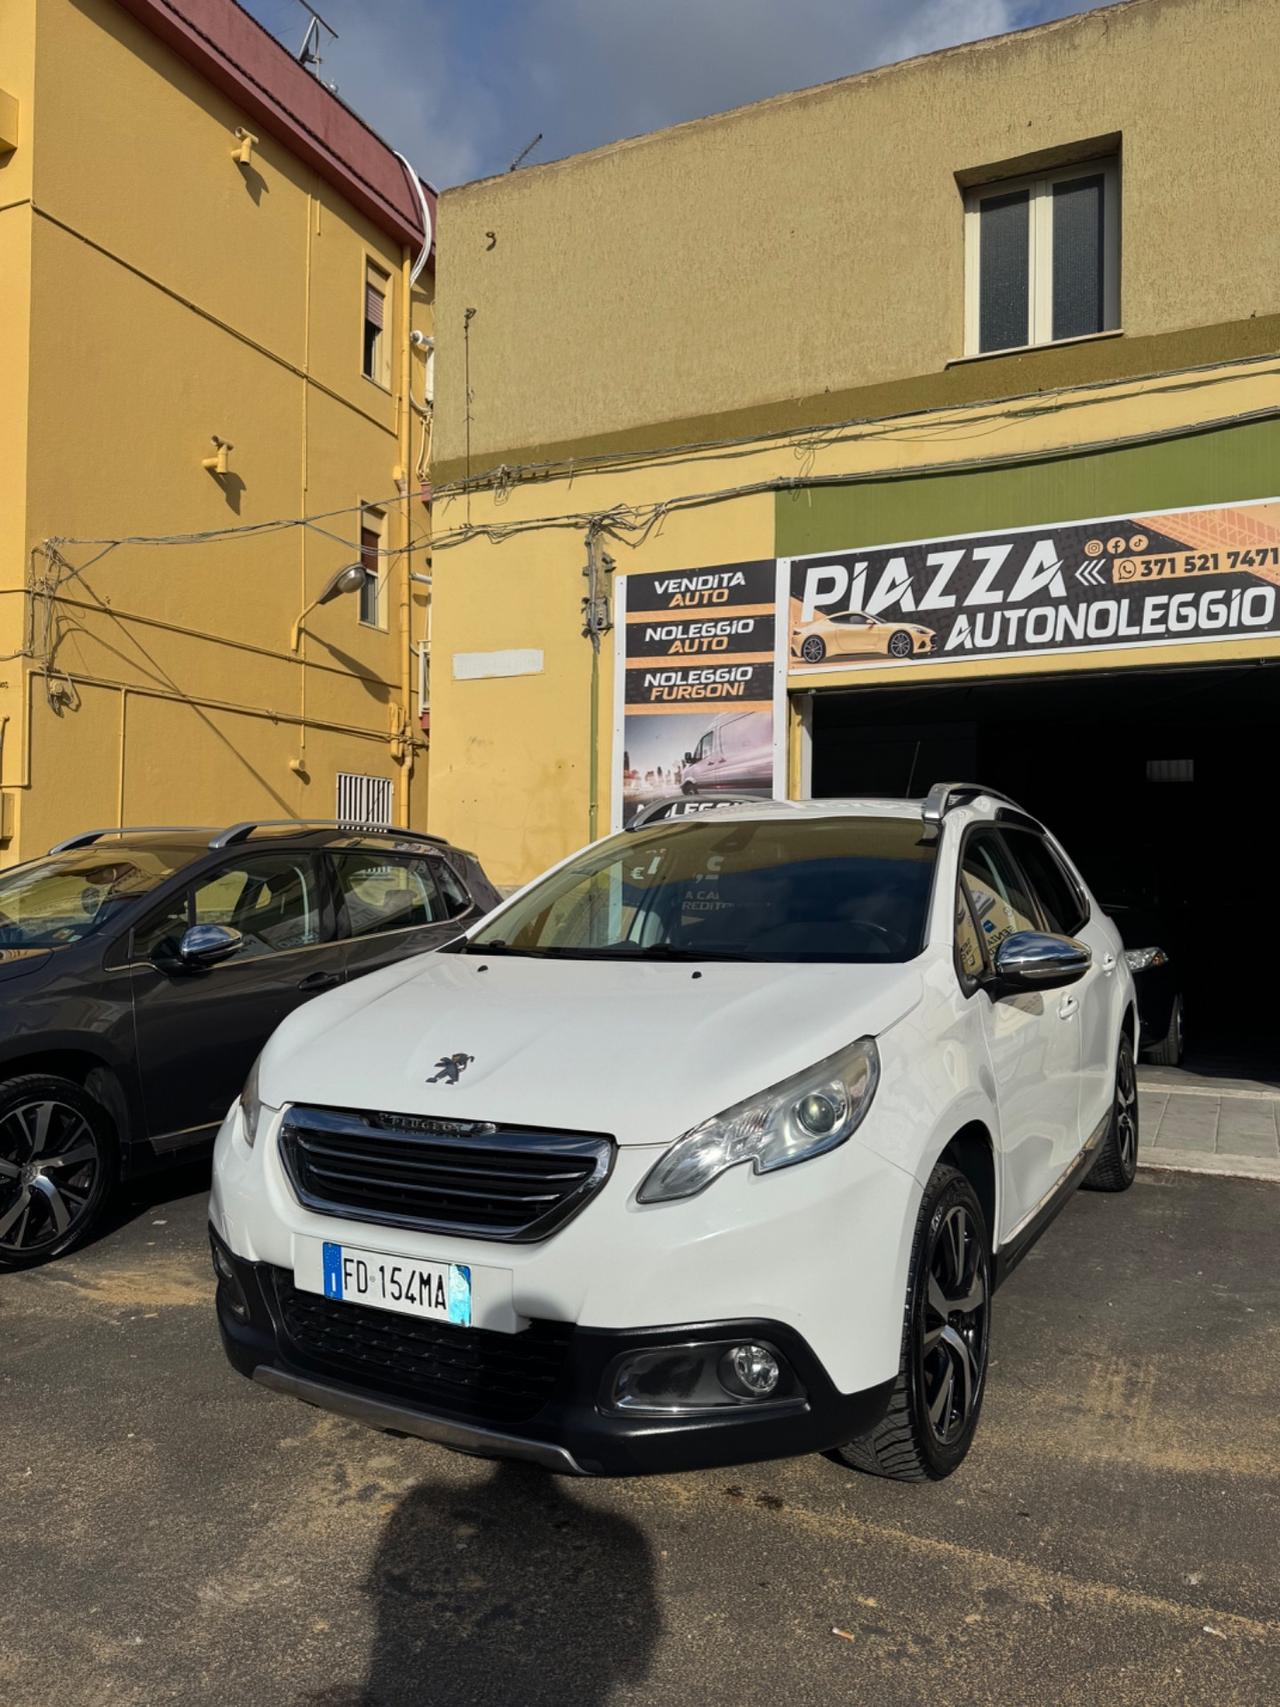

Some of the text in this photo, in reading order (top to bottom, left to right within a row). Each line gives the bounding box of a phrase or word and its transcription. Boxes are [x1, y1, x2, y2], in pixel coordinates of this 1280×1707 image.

[1140, 547, 1279, 577] 371 521 7471
[654, 571, 746, 595] VENDITA
[801, 538, 1067, 623] PIAZZA
[668, 588, 730, 608] AUTO
[943, 585, 1276, 651] AUTONOLEGGIO
[644, 619, 755, 642] NOLEGGIO
[667, 636, 729, 655] AUTO
[643, 666, 754, 688] NOLEGGIO
[650, 681, 746, 701] FURGONI
[343, 1257, 447, 1310] FD 154MA
